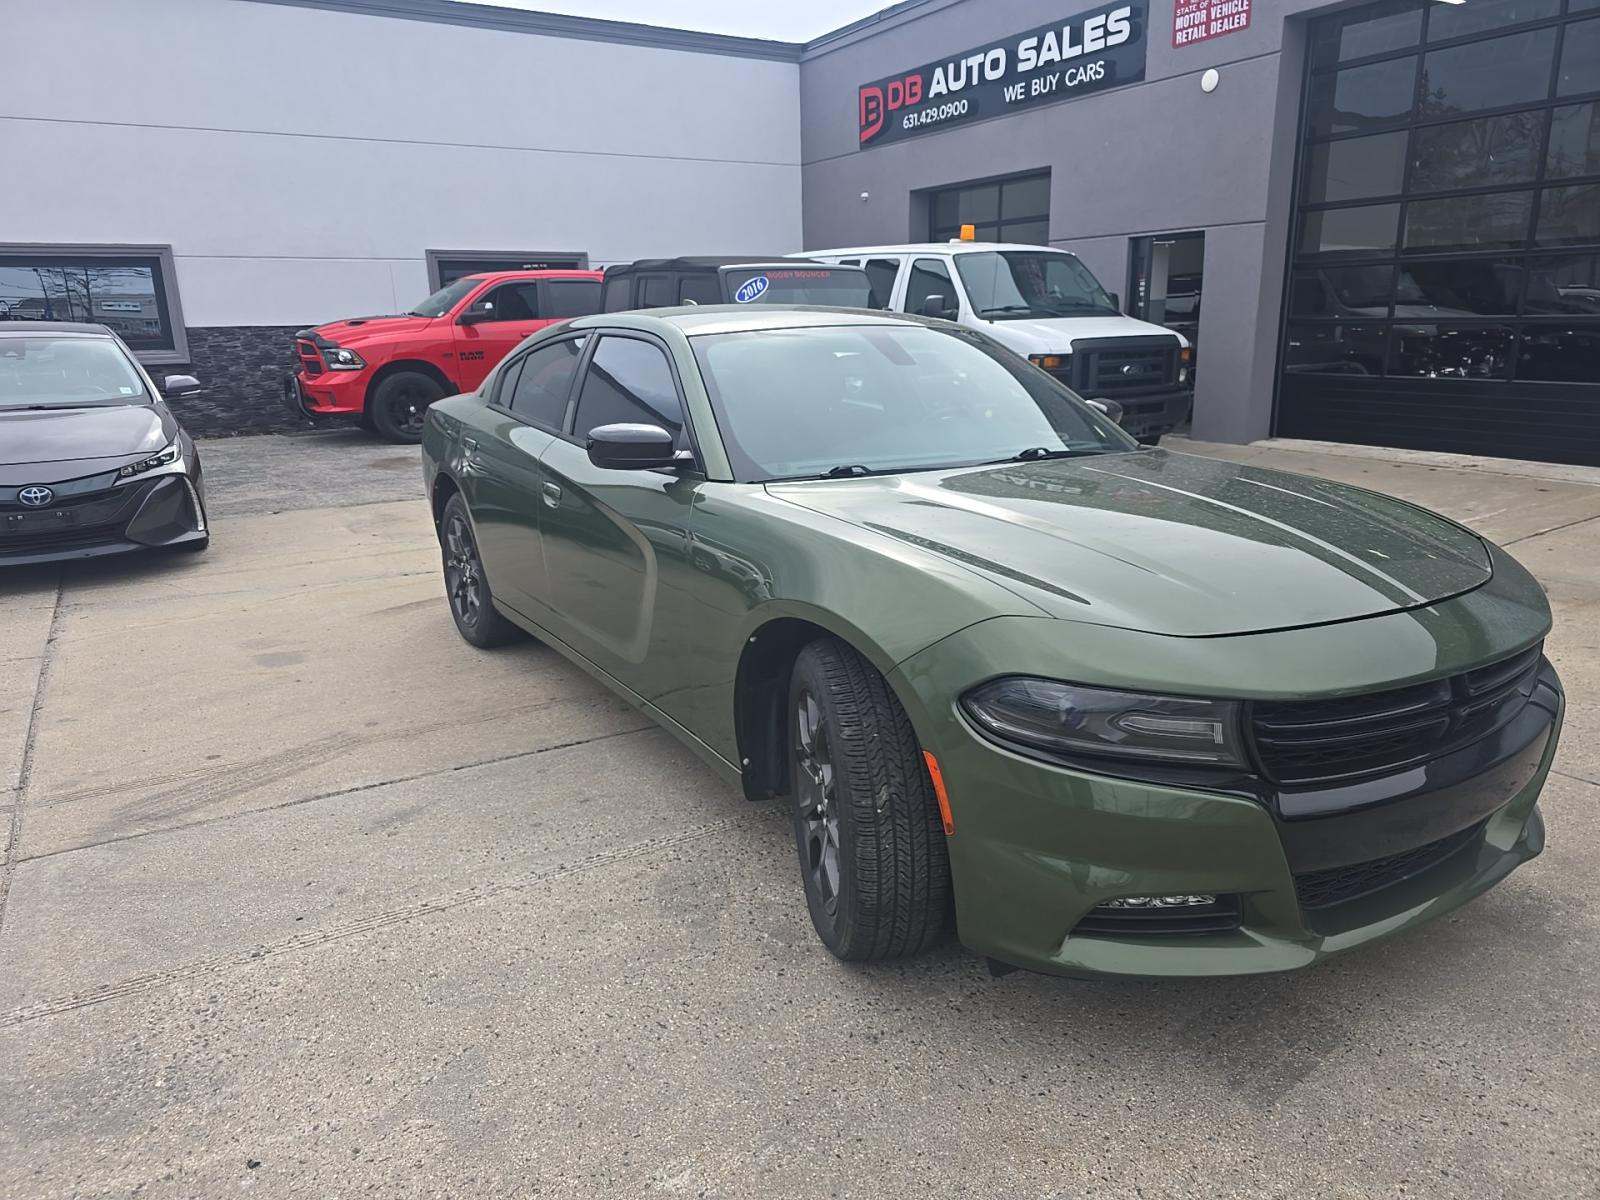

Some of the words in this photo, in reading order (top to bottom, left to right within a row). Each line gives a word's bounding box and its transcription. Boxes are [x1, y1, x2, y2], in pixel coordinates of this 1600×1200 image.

[1175, 10, 1207, 30] MOTOR
[1210, 0, 1249, 20] VEHICLE
[1176, 5, 1197, 16] STATE
[1176, 25, 1207, 44] RETAIL
[1209, 13, 1247, 35] DEALER
[888, 75, 923, 110] DB
[928, 47, 1007, 98] AUTO
[1017, 5, 1131, 72] SALES
[1004, 82, 1026, 103] WE
[1032, 72, 1060, 96] BUY
[1065, 61, 1105, 86] CARS
[903, 99, 968, 129] 631.429.0900
[741, 278, 763, 301] 2016
